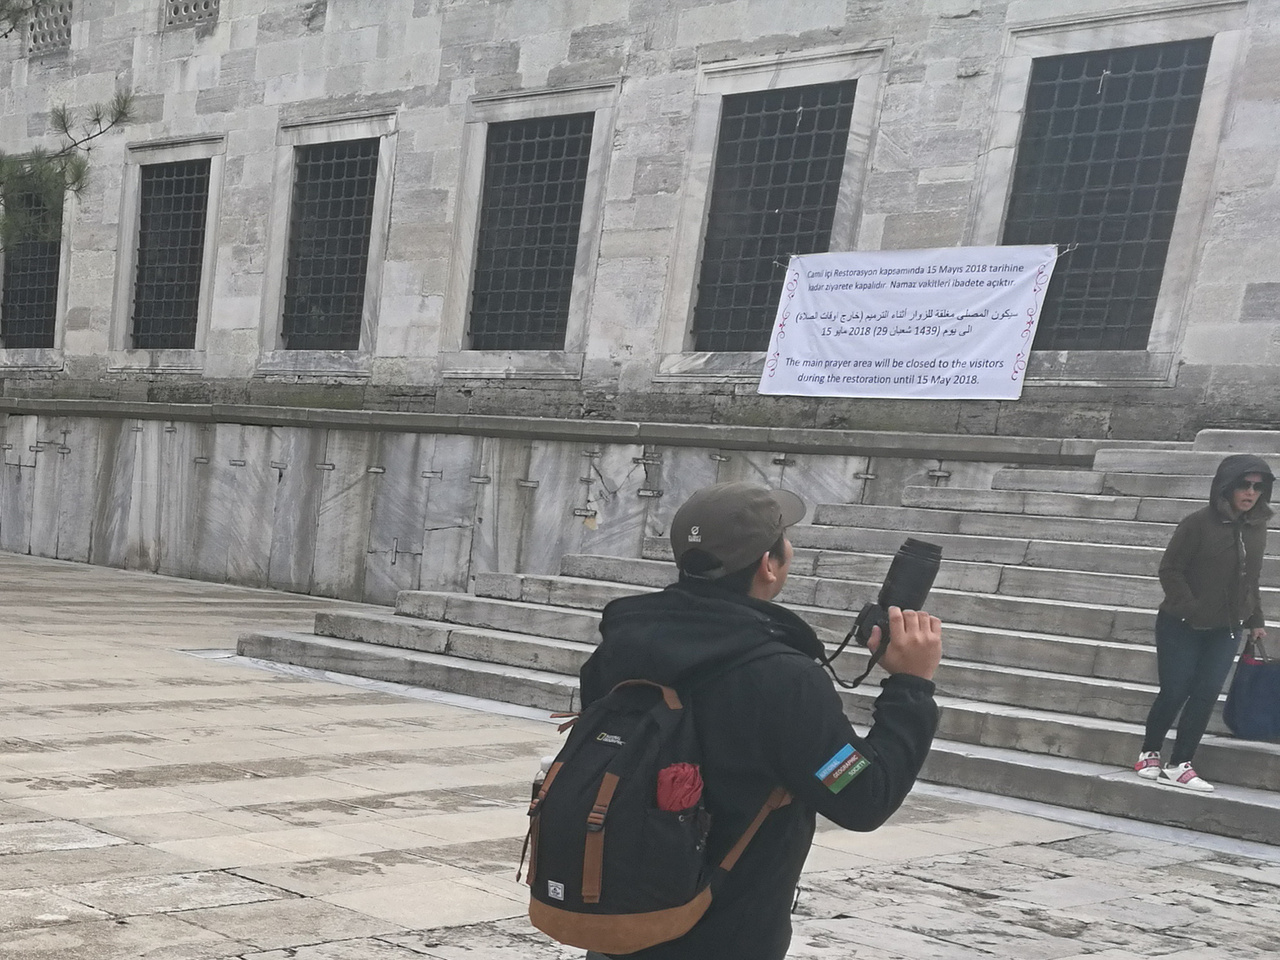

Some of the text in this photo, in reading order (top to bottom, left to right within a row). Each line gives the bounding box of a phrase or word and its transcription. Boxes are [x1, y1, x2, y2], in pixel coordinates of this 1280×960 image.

[833, 268, 878, 278] Restorasyon
[879, 266, 924, 276] kapsamında
[926, 265, 937, 274] 15
[938, 265, 964, 275] Mayıs
[964, 264, 987, 273] 2018
[989, 263, 1024, 273] tarihine
[825, 282, 853, 293] ziyarete
[890, 280, 917, 289] Namaz
[918, 278, 950, 288] vakitleri
[951, 278, 985, 288] ibadete
[986, 278, 1016, 288] açıktır.
[821, 327, 832, 336] 15
[849, 326, 871, 336] 2018
[786, 357, 1004, 370] The main prayer area will be closed to the visitors
[797, 373, 980, 386] during the restoration until 15 May 2018.
